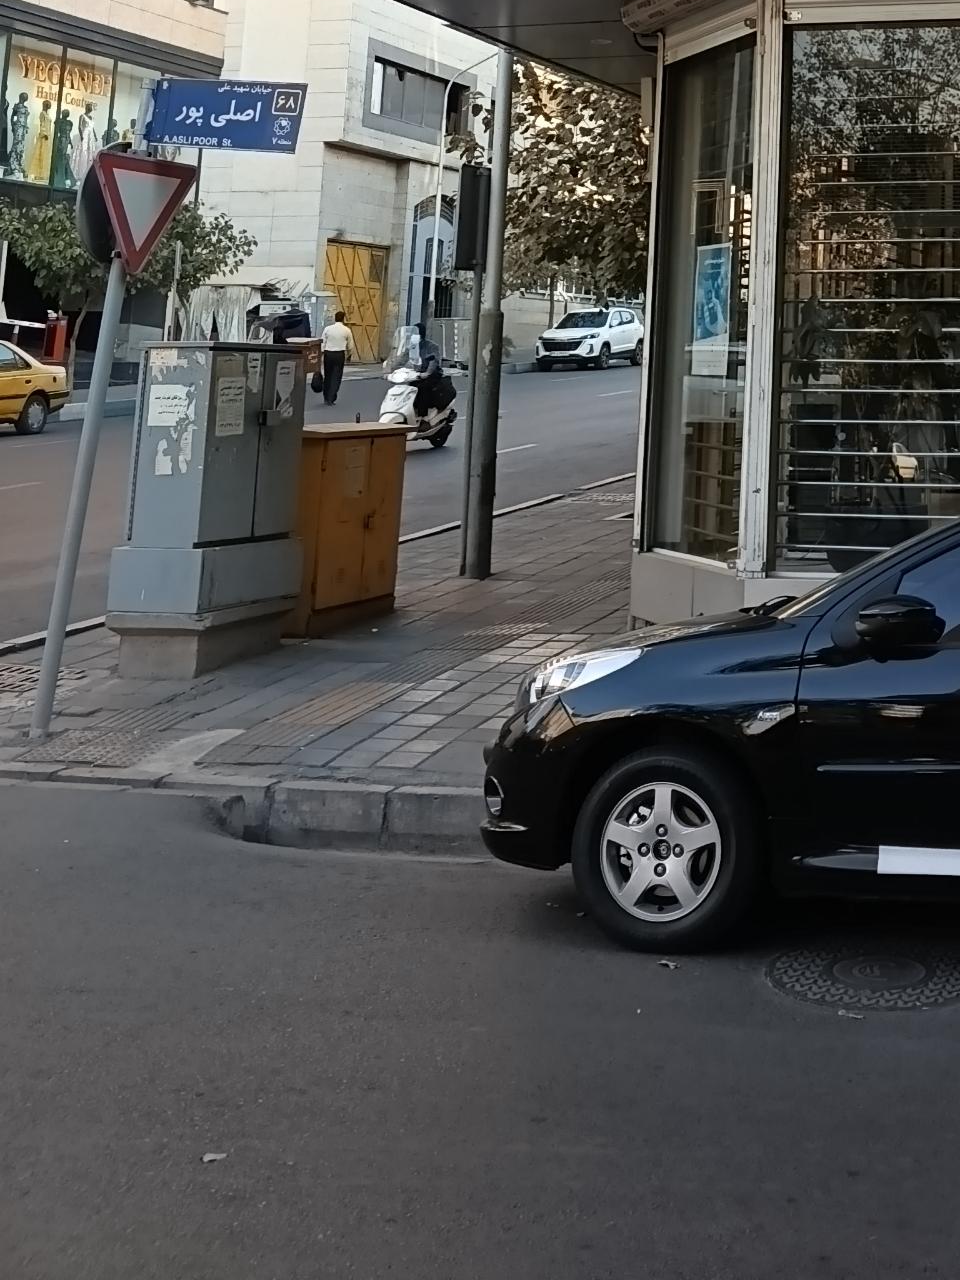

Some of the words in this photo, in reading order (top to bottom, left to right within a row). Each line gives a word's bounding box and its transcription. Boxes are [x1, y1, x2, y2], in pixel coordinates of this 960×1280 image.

[217, 82, 231, 93] علی
[232, 84, 250, 93] شهید
[251, 84, 273, 95] خیابان
[276, 95, 295, 109] ۶۸
[174, 104, 204, 127] پور
[209, 99, 262, 128] اصلی
[163, 134, 192, 145] A.ASLI
[193, 136, 218, 147] POOR
[222, 137, 233, 147] St.
[272, 136, 278, 145] ۷
